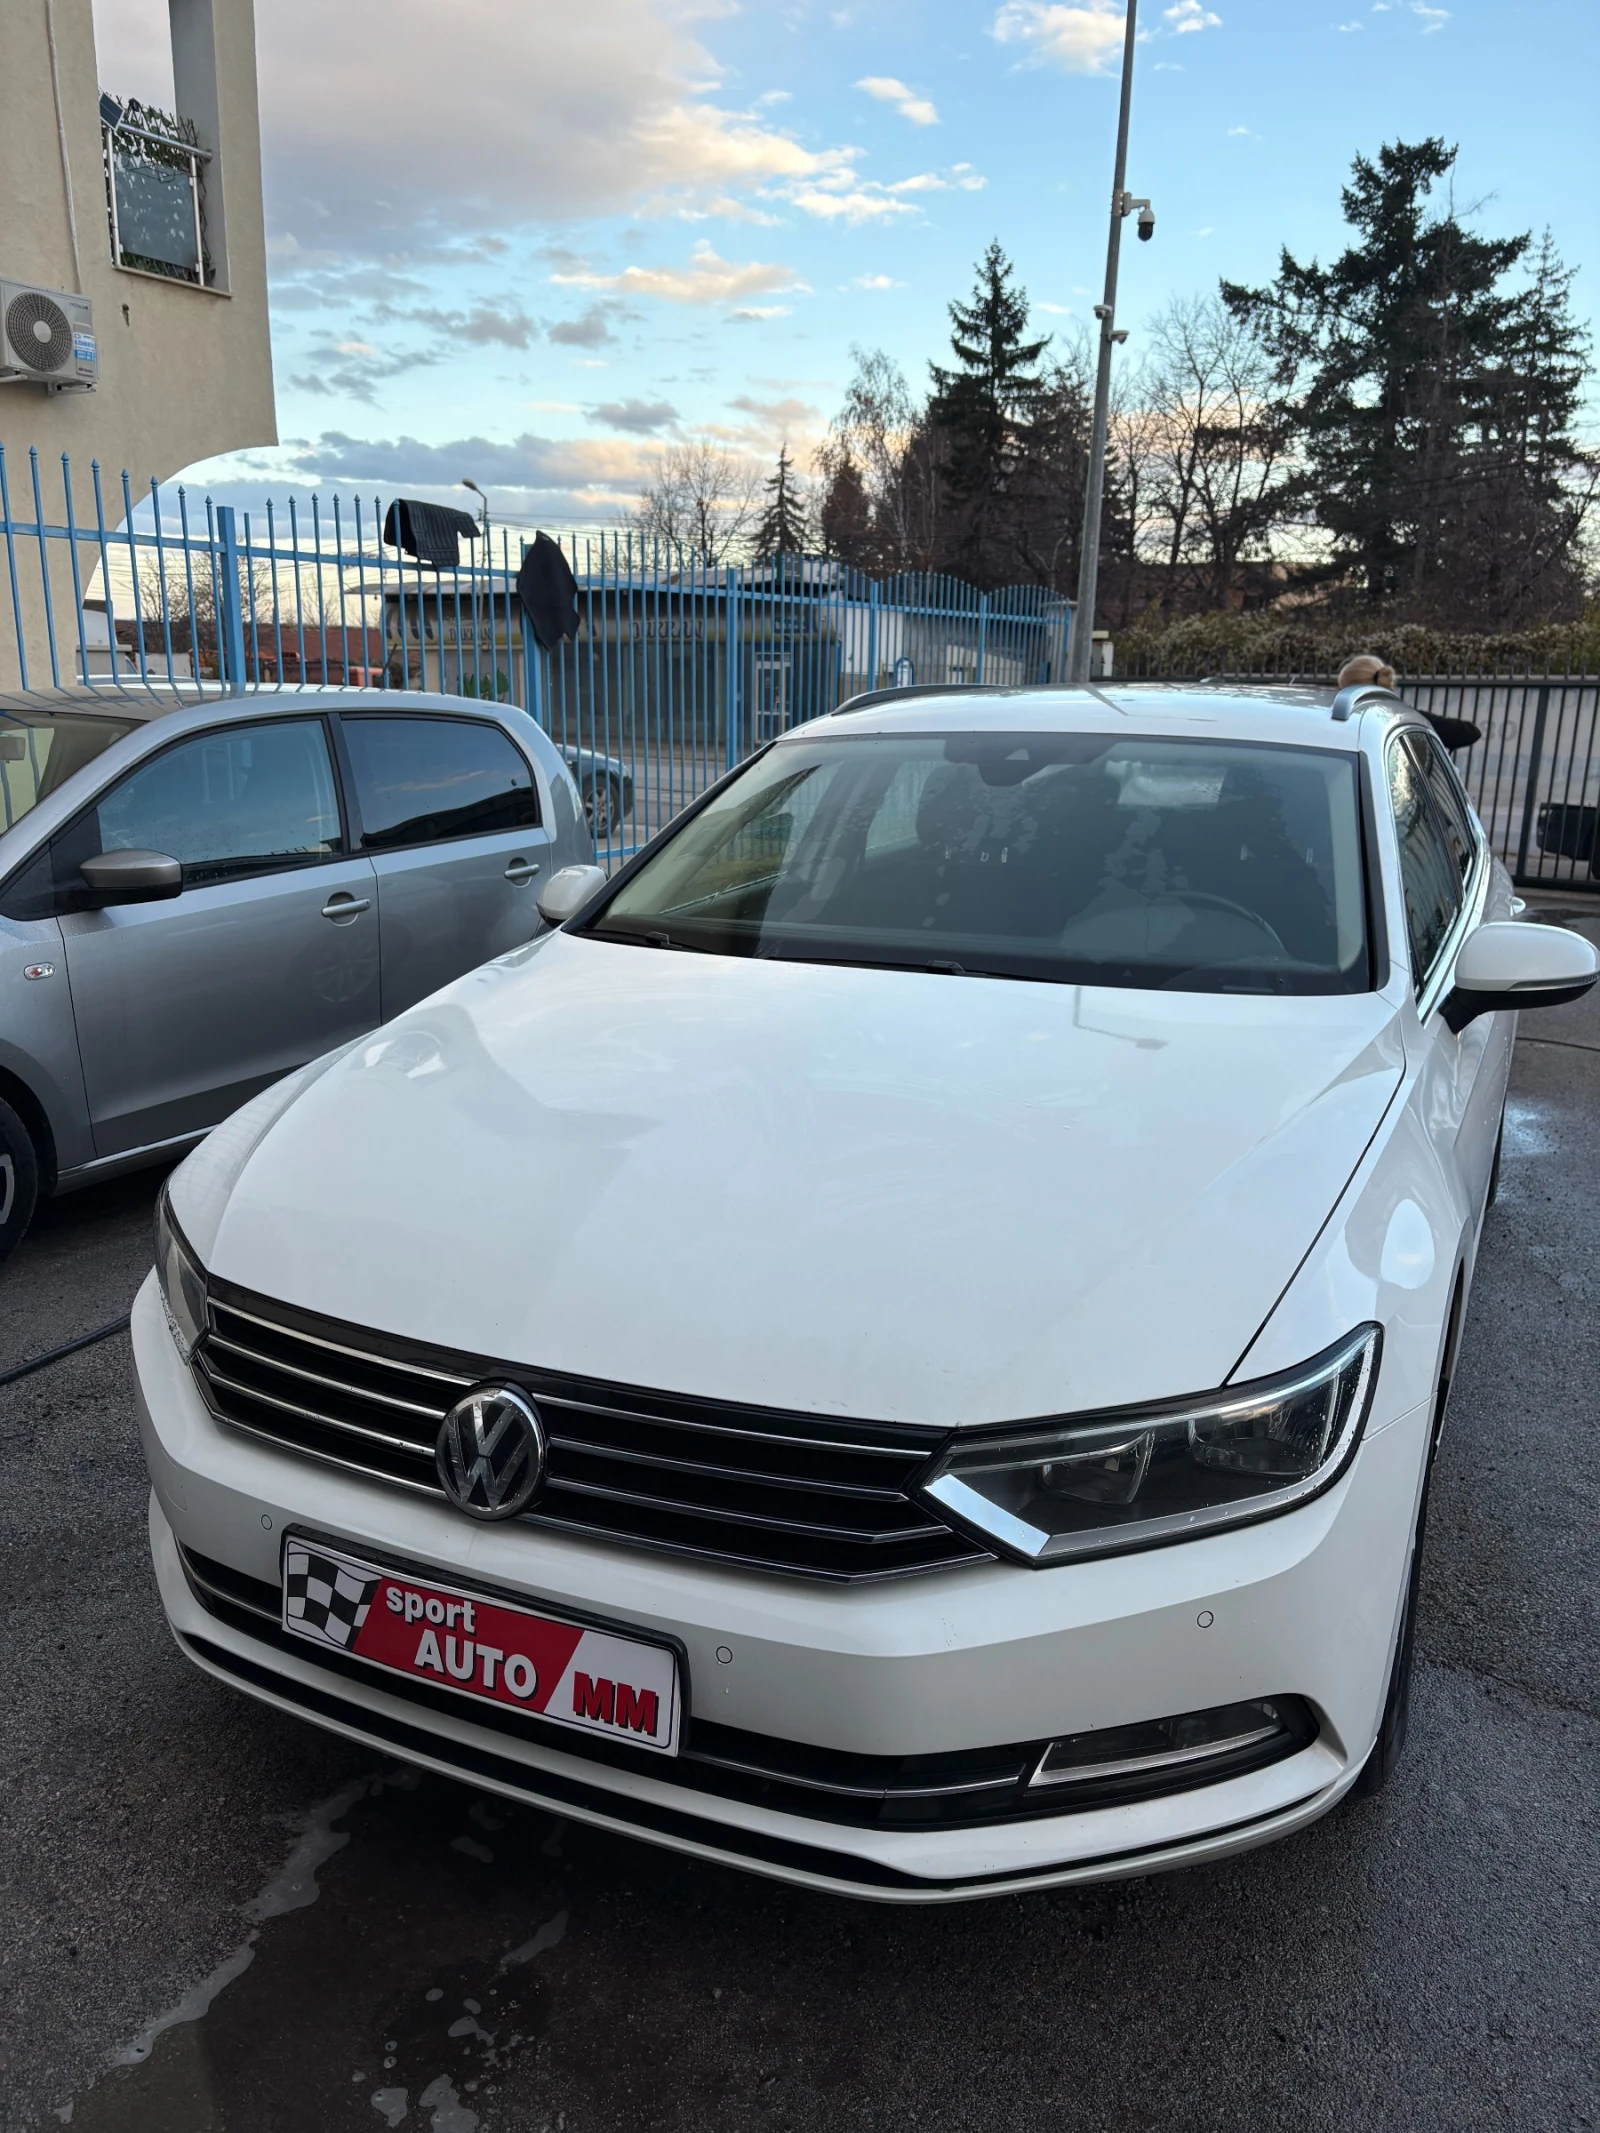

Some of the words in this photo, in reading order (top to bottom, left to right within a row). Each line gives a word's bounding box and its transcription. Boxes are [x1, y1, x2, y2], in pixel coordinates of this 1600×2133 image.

[386, 1586, 476, 1634] sport
[414, 1629, 538, 1699] AUTO
[571, 1671, 660, 1738] MM
